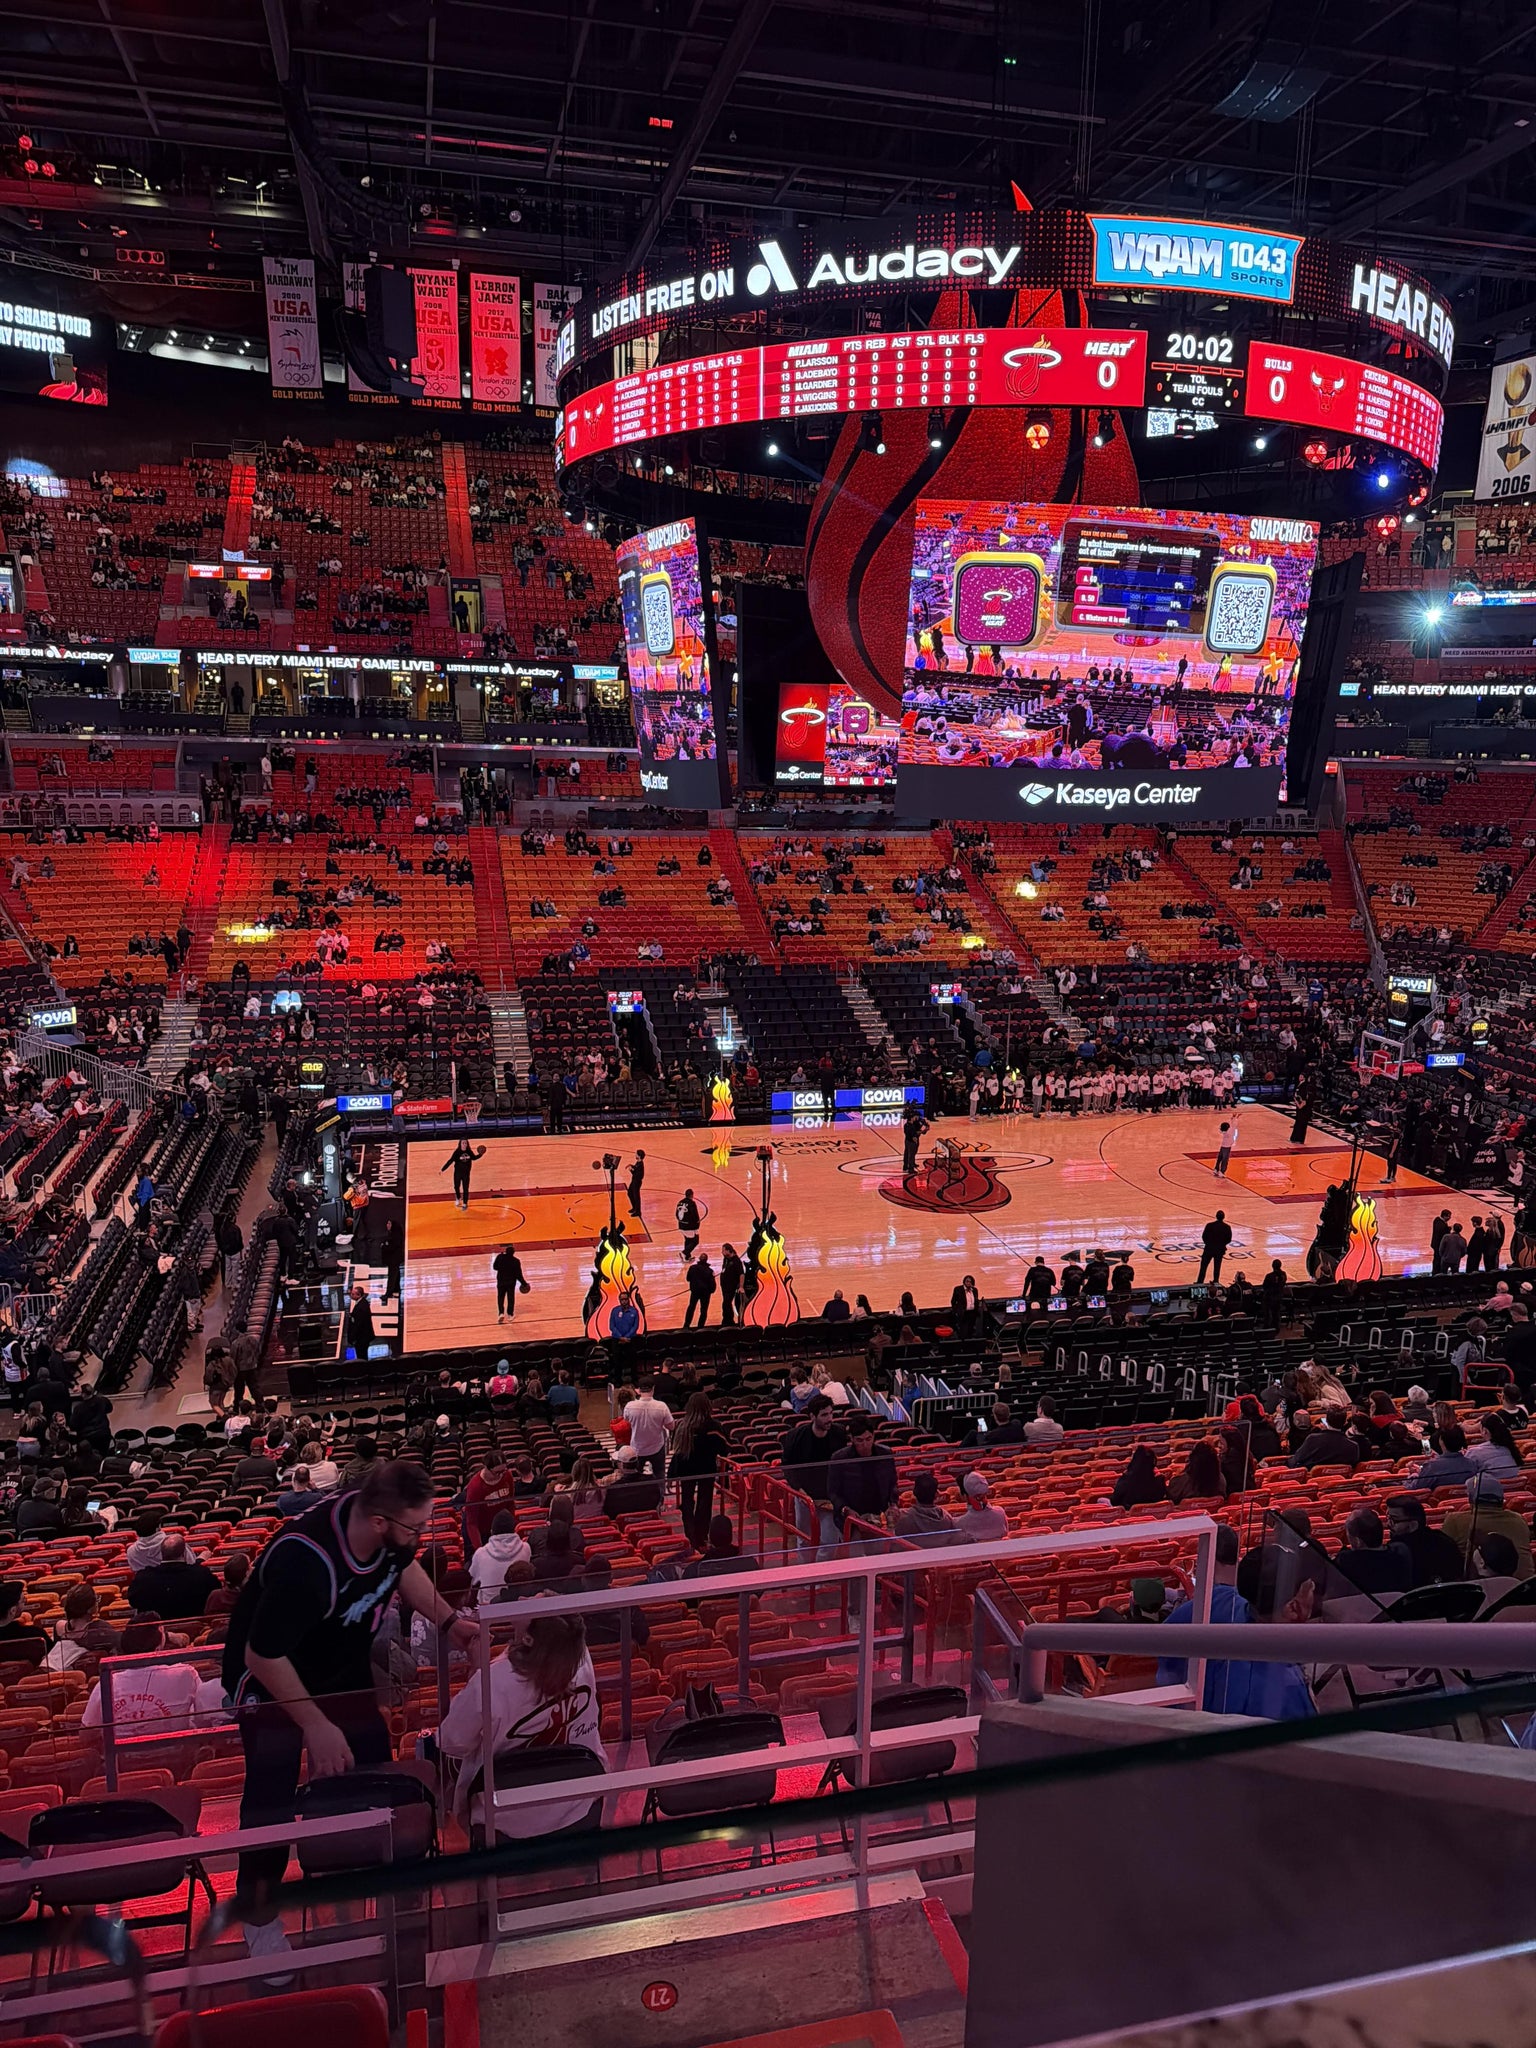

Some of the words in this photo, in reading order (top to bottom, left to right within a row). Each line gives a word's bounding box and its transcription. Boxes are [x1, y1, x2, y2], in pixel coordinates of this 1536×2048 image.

[1107, 231, 1223, 278] WQAM
[280, 264, 298, 275] TIM
[807, 245, 1021, 289] Audacy
[266, 275, 314, 288] HARDAWAY
[1230, 271, 1285, 288] SPORTS
[416, 285, 449, 298] WADE
[474, 280, 516, 294] LEBRON
[477, 291, 514, 305] JAMES
[546, 288, 569, 301] BAM
[1350, 263, 1429, 339] HEAR
[272, 299, 312, 316] USA
[592, 293, 641, 338] LISTEN
[645, 277, 695, 316] FREE
[699, 268, 734, 301] ON
[416, 308, 453, 326] USA
[487, 309, 505, 317] 2012
[14, 304, 57, 330] SHARE
[57, 312, 92, 338] YOUR
[477, 316, 515, 333] USA
[13, 328, 66, 354] PHOTOS
[787, 342, 828, 357] MIAMI
[843, 341, 862, 351] PTS
[865, 338, 886, 349] REB
[891, 336, 912, 348] AST
[916, 335, 936, 346] STL
[938, 334, 960, 345] BLK
[964, 333, 985, 344] FLS
[1084, 338, 1137, 356] HEAT
[1166, 333, 1233, 363] 20:02
[676, 364, 689, 376] AST
[692, 361, 707, 372] STL
[708, 357, 724, 370] BLK
[726, 354, 742, 365] FLS
[783, 361, 789, 370] 9
[795, 355, 839, 368] P.LARSSON
[1264, 357, 1293, 372] BULLS
[780, 372, 790, 381] 13
[795, 368, 838, 380] B.ADEBAYO
[1098, 361, 1117, 388] 0
[1165, 373, 1172, 382] 7
[1190, 374, 1207, 384] TOL
[1226, 378, 1233, 387] 7
[272, 389, 294, 399] GOLD
[295, 390, 325, 400] MEDAL
[780, 384, 790, 393] 15
[1157, 383, 1163, 392] 0
[1172, 383, 1196, 394] TEAM
[1196, 385, 1224, 397] FOULS
[1233, 389, 1239, 398] 0
[1269, 376, 1285, 402] 0
[348, 393, 370, 403] GOLD
[371, 395, 400, 404] MEDAL
[411, 398, 433, 408] GOLD
[433, 399, 462, 410] MEDAL
[780, 395, 790, 404] 22
[1192, 397, 1205, 407] CC
[472, 401, 493, 411] GOLD
[494, 403, 522, 413] MEDAL
[535, 408, 555, 418] GOLD
[780, 406, 790, 415] 25
[1490, 474, 1531, 498] 2006
[647, 523, 682, 551] SNAPCHAT
[1249, 518, 1305, 543] SNAPCHAT
[10, 647, 37, 657] FREE
[37, 648, 44, 657] ON
[64, 651, 114, 663] Audacy
[197, 652, 234, 665] HEAR
[236, 654, 280, 666] EVERY
[282, 655, 324, 668] MIAMI
[326, 657, 360, 669] HEAT
[361, 659, 400, 671] GAME
[402, 660, 435, 672] LIVE!
[446, 663, 470, 672] LISTEN
[471, 665, 488, 673] FREE
[516, 667, 560, 679] Audacy
[1373, 684, 1406, 696] HEAR
[1407, 684, 1448, 696] EVERY
[1448, 684, 1488, 696] MIAMI
[1490, 685, 1522, 696] HEAT
[776, 771, 800, 781] Kaseya
[800, 772, 822, 780] Center
[1056, 783, 1131, 810] Kaseya
[1134, 782, 1202, 804] Center
[301, 1062, 324, 1072] 20:02
[350, 1096, 381, 1107] GOYA
[864, 1089, 903, 1102] GOYA
[573, 1122, 630, 1132] Baptist
[632, 1120, 685, 1129] Health
[770, 1138, 858, 1149] Kaseya
[776, 1145, 861, 1156] Center
[371, 1142, 400, 1188] Robinhood
[1136, 1239, 1247, 1253] Kasea
[130, 1693, 154, 1703] TACO
[650, 1987, 671, 2007] 27
